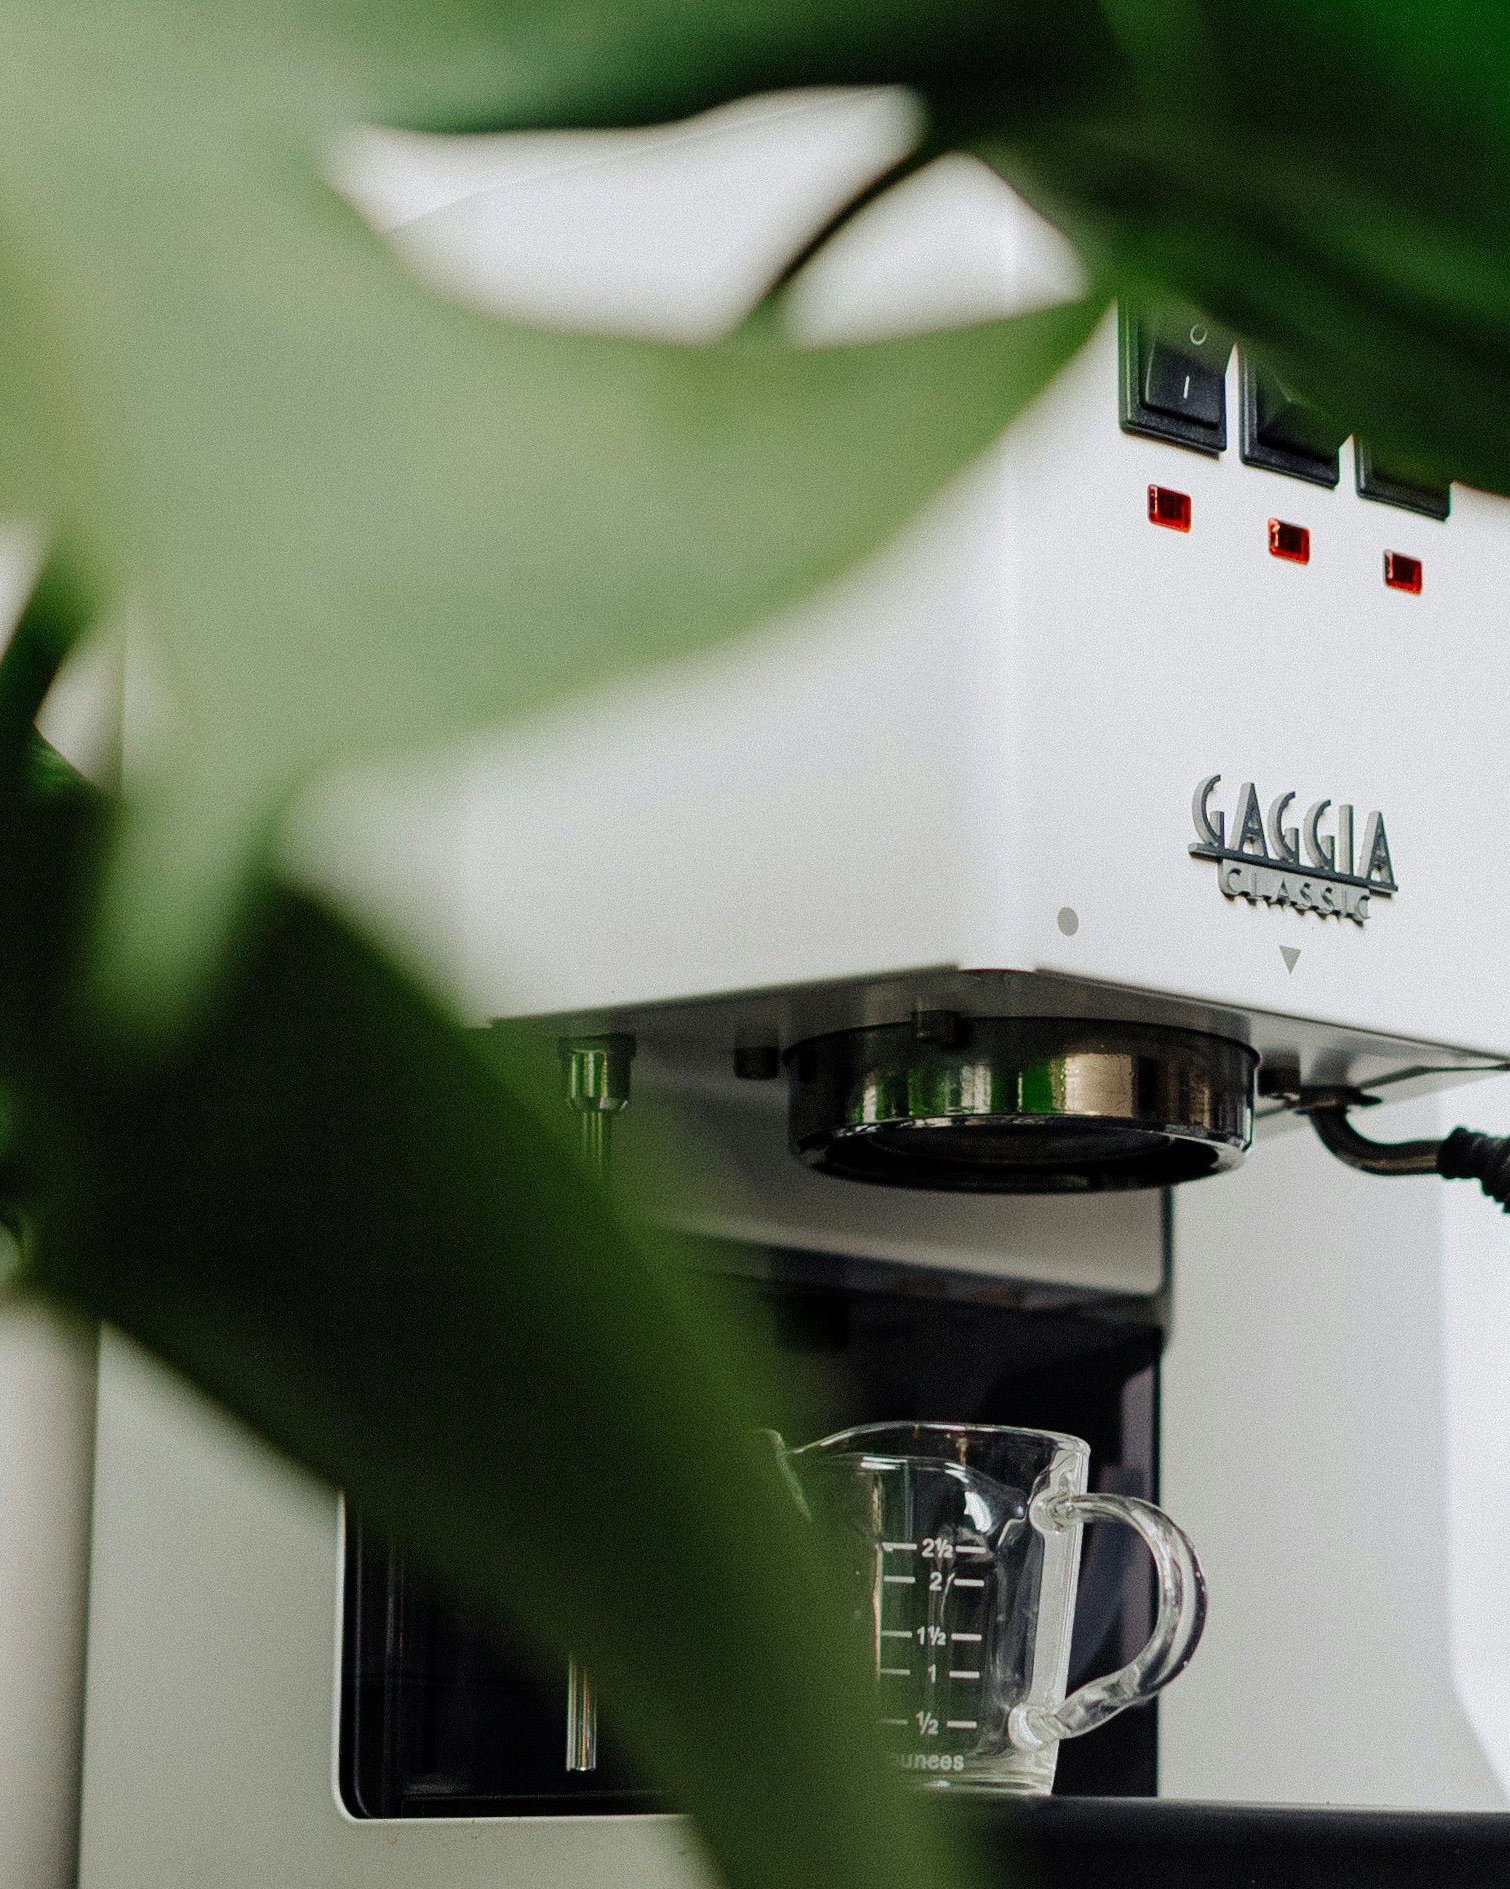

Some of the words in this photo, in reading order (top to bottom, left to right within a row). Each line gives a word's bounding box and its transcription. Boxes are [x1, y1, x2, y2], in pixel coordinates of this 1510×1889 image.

[1191, 774, 1396, 888] GAGGIA
[1226, 867, 1372, 921] CLASSIC
[929, 1571, 943, 1591] 2
[928, 1663, 936, 1683] 1
